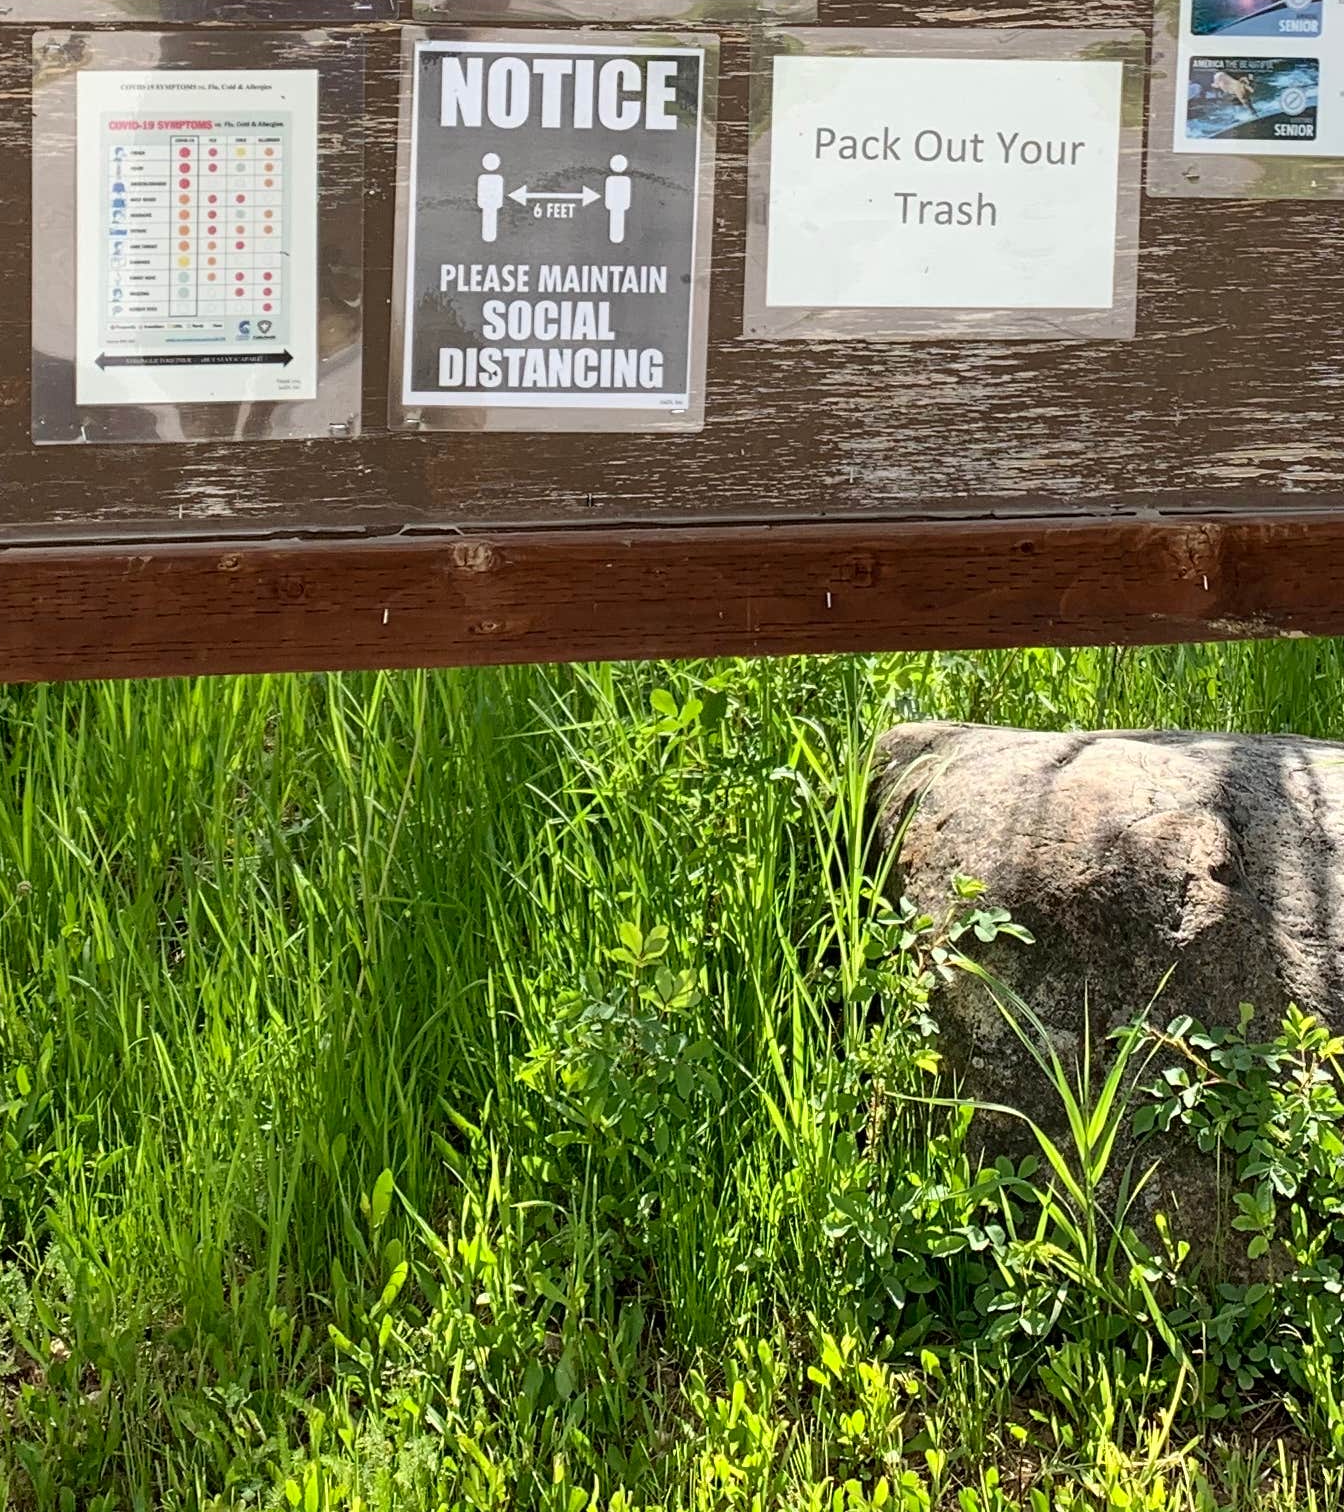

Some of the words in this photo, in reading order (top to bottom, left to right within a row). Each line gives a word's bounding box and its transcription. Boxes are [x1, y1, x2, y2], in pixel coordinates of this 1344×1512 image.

[1278, 19, 1319, 33] SENIOR
[441, 56, 678, 132] NOTICE
[109, 120, 155, 130] COVID-19
[157, 120, 213, 130] SYMPTOMS
[1274, 124, 1314, 137] SENIOR
[815, 127, 901, 162] Pack
[914, 129, 985, 163] Out
[996, 131, 1086, 166] Your
[533, 203, 542, 219] 6
[545, 203, 576, 220] FEET
[894, 191, 997, 227] Trash
[440, 264, 530, 293] PLEASE
[537, 264, 668, 295] MAINTAIN
[482, 299, 615, 341] SOCIAL
[439, 347, 664, 389] DISTANCING
